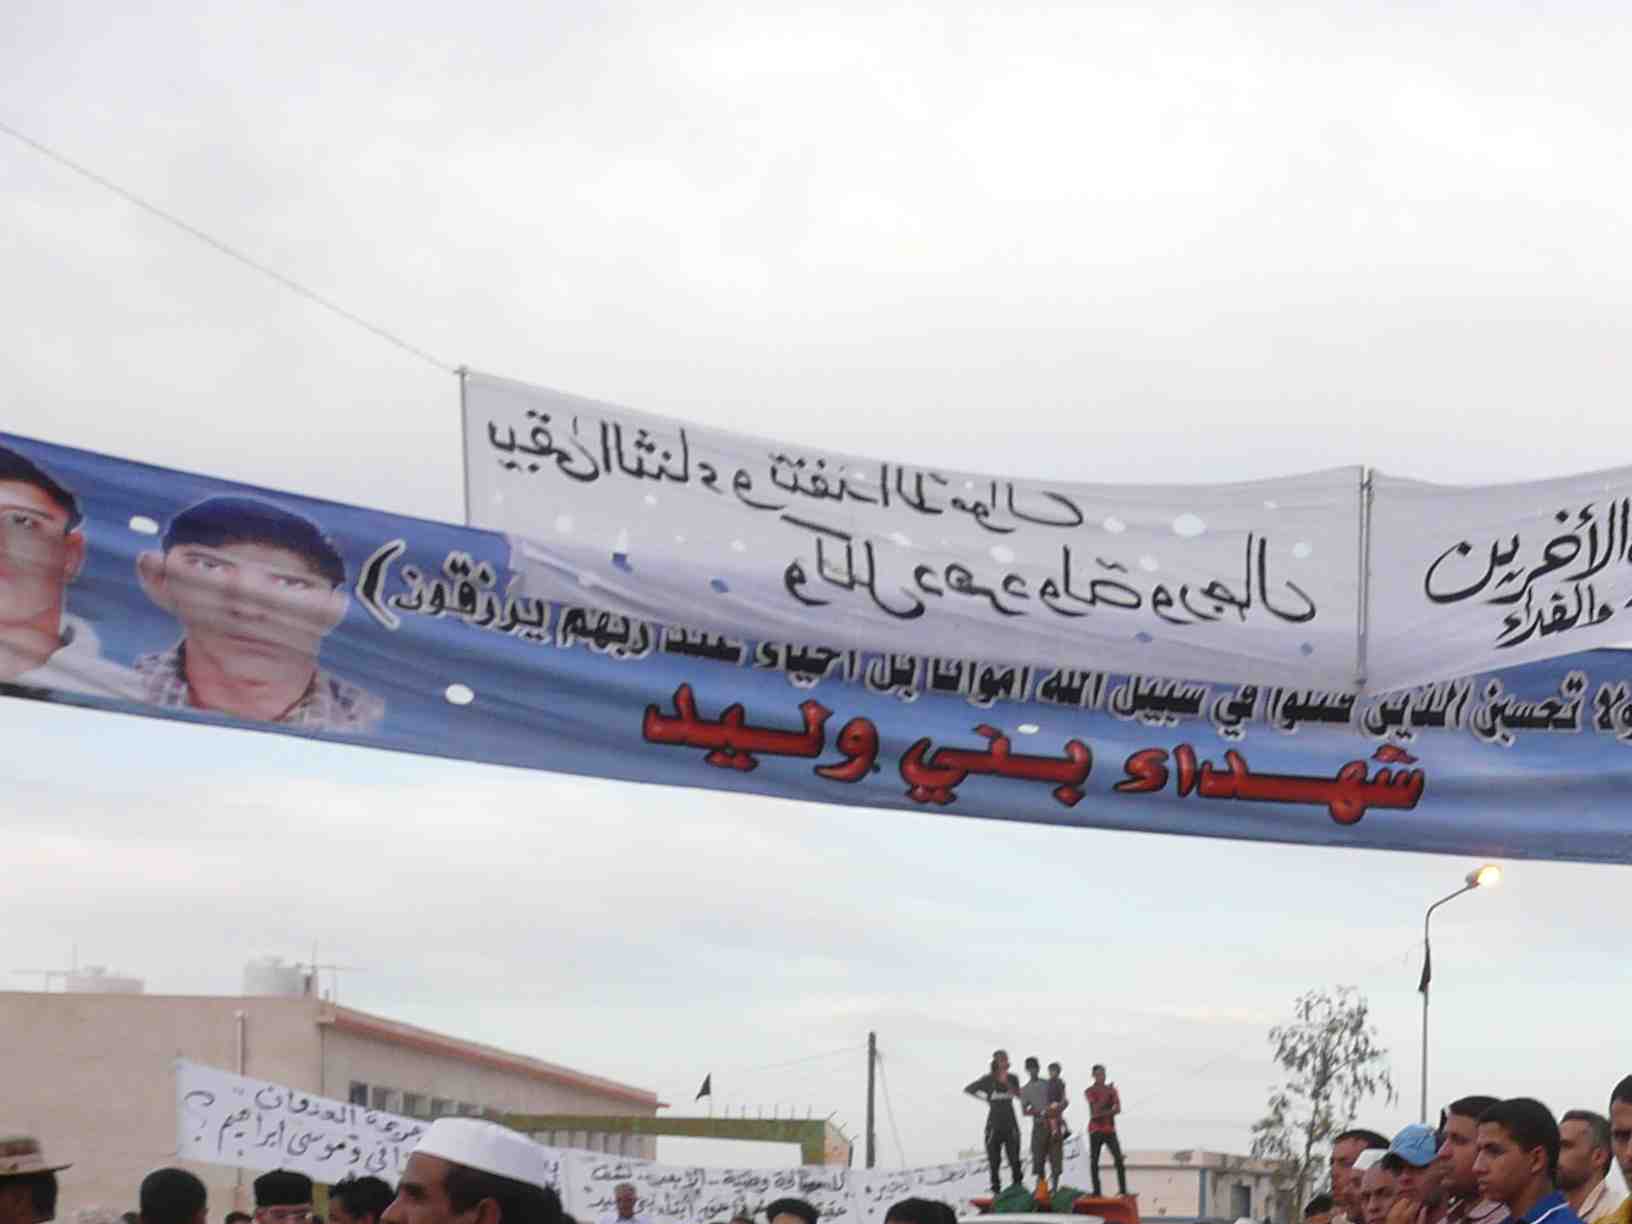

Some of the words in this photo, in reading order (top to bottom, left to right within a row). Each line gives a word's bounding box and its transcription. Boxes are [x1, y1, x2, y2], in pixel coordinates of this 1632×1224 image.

[642, 681, 881, 784] وليد
[900, 723, 1093, 808] بني
[1112, 742, 1427, 826] شهداء
